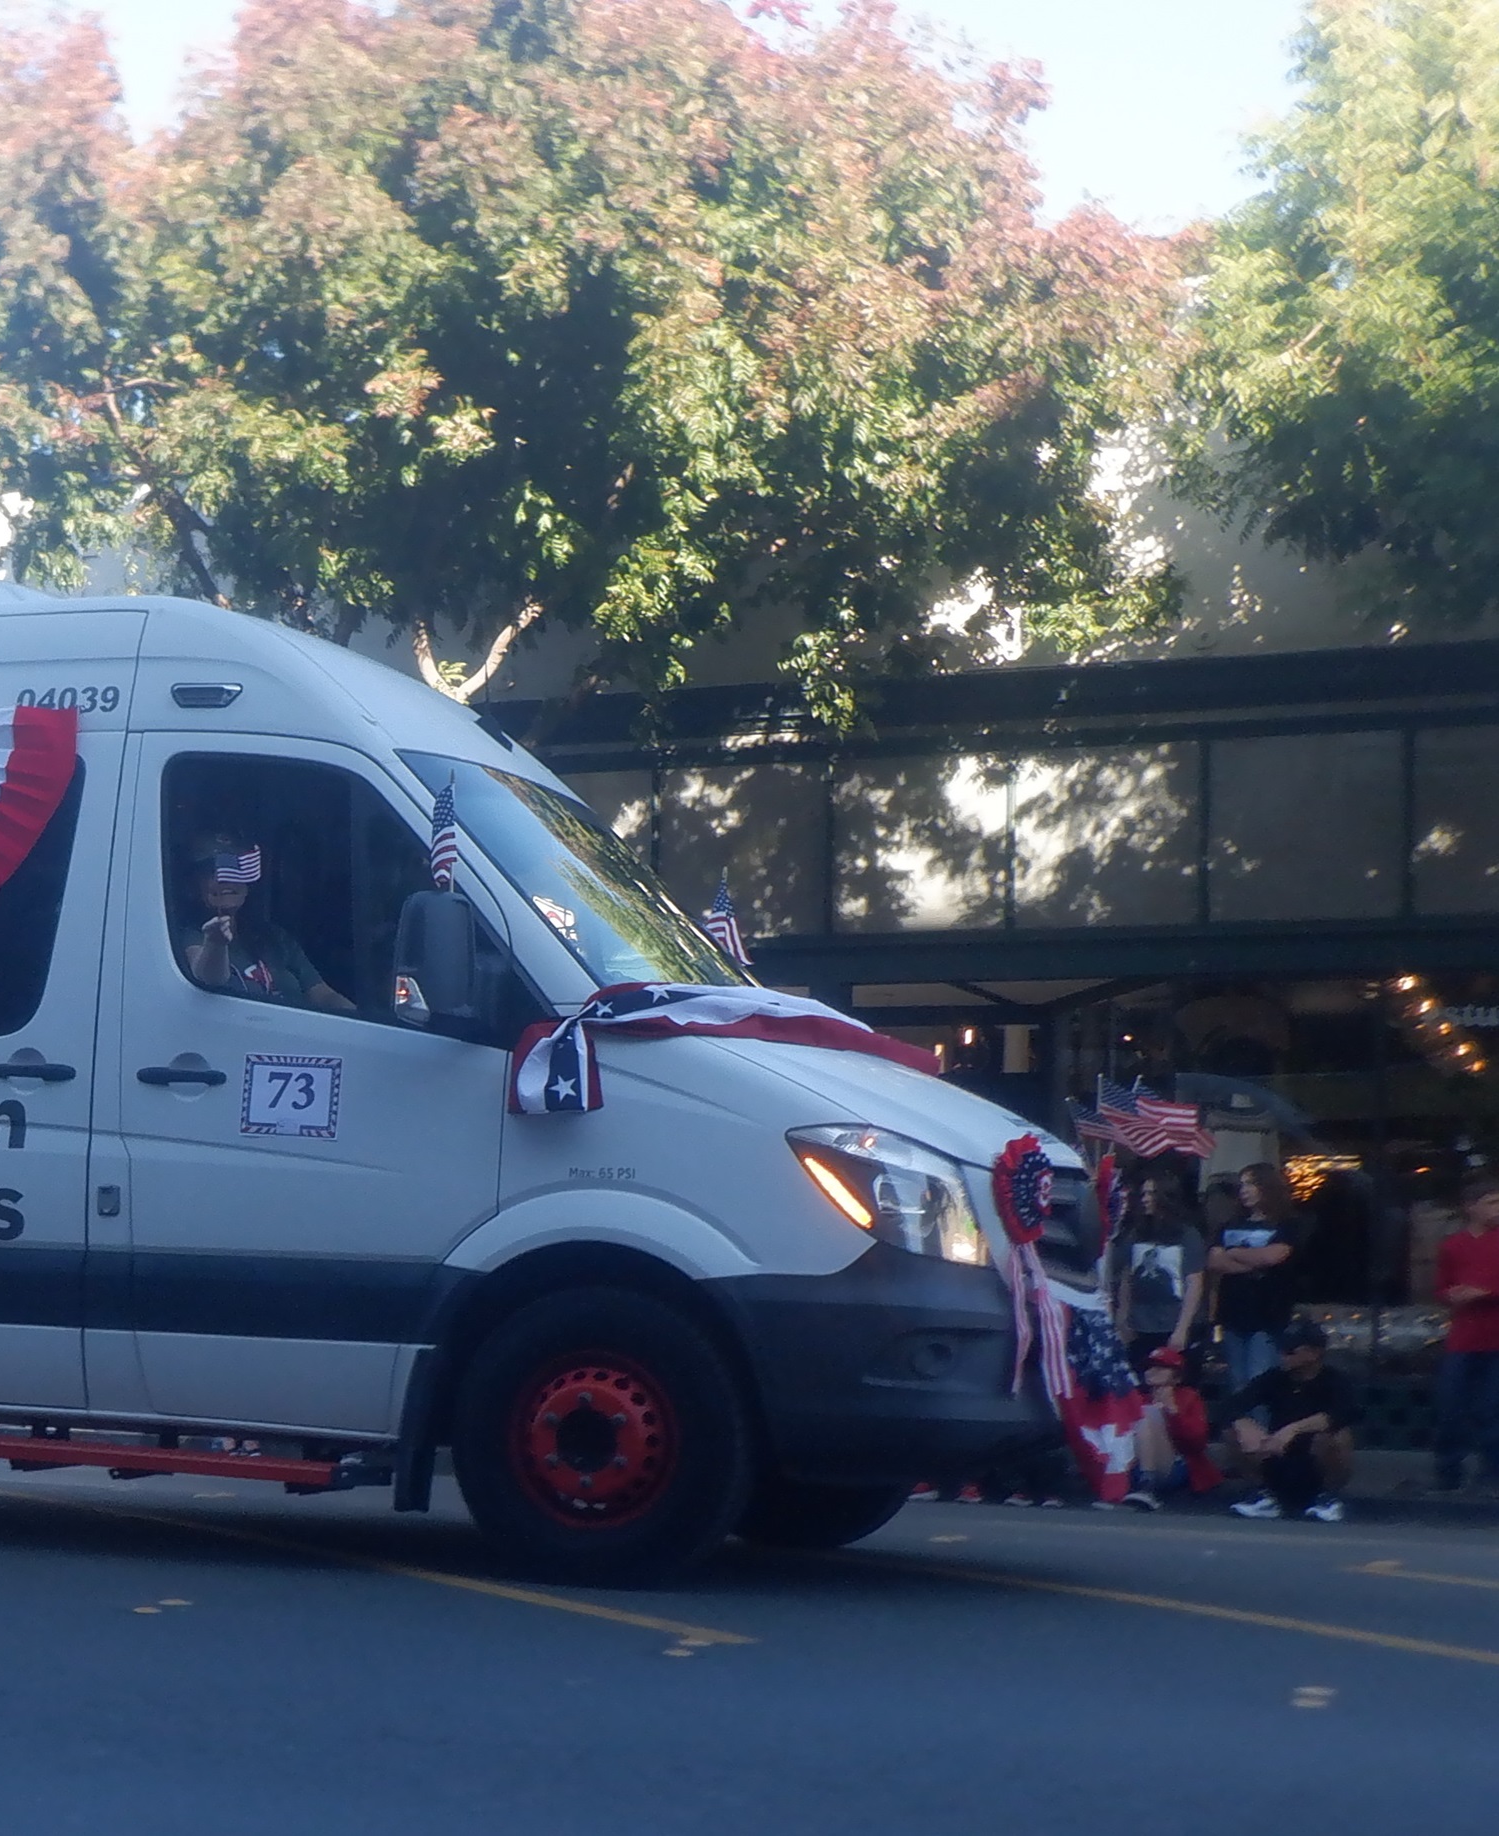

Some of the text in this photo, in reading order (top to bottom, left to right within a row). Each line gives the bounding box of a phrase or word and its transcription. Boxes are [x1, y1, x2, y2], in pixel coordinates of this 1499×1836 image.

[17, 686, 120, 714] 04039
[268, 1071, 315, 1110] 73
[598, 1167, 614, 1180] 65
[617, 1167, 636, 1180] PSI
